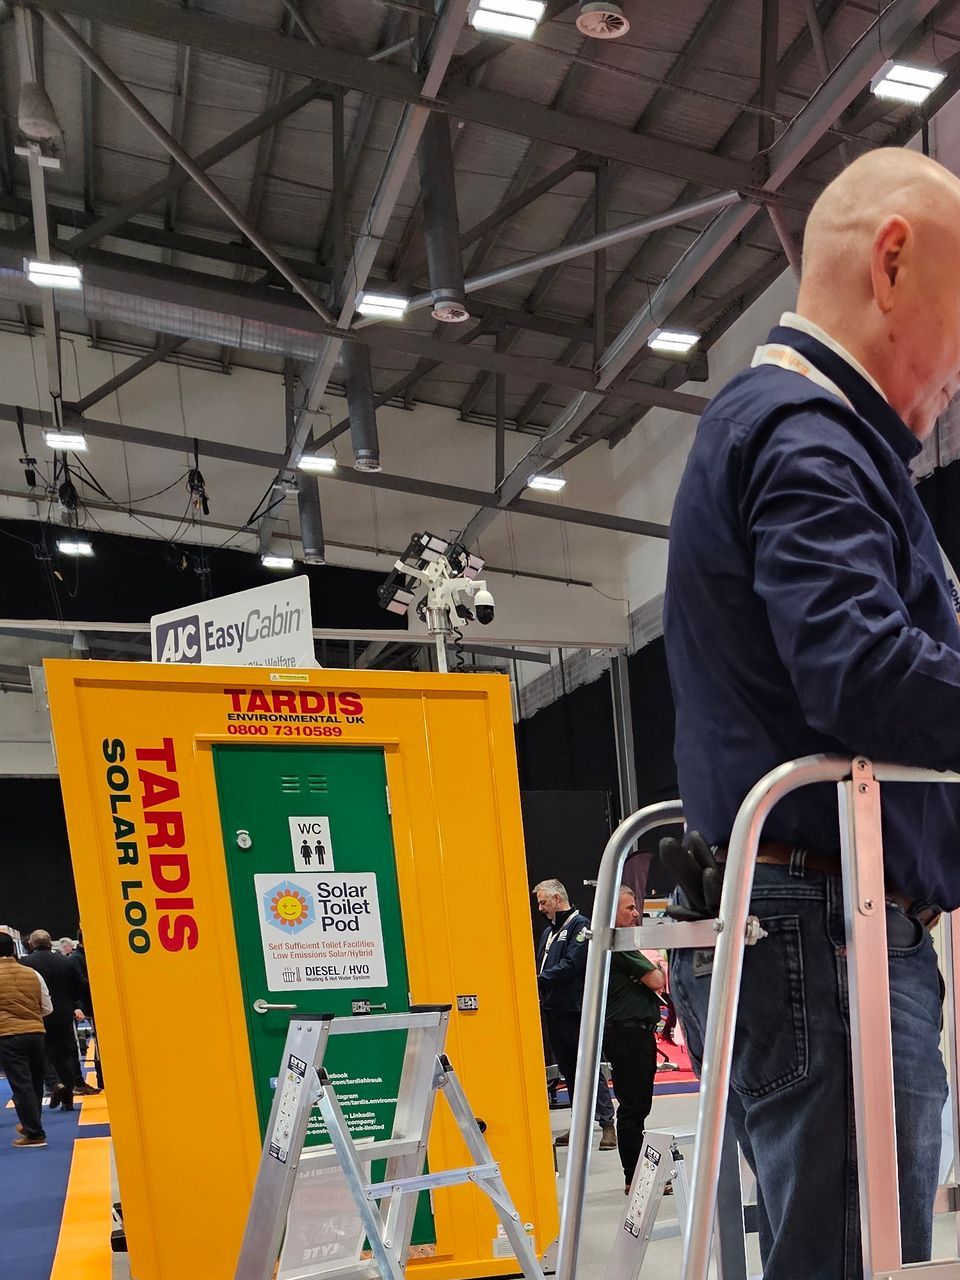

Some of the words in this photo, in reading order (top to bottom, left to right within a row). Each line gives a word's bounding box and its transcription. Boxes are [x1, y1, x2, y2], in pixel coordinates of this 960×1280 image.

[160, 625, 199, 662] AJC
[205, 601, 301, 653] EasyCabin
[224, 688, 364, 715] TARDIS
[227, 713, 342, 724] ENVIRONMENTAL
[346, 716, 365, 724] UK
[227, 724, 269, 735] 0800
[273, 725, 342, 737] 7310589
[298, 823, 321, 834] WC
[102, 737, 139, 866] SOLAR
[121, 880, 151, 954] LOO
[135, 737, 199, 953] TARDIS
[317, 882, 367, 898] Solar
[318, 900, 370, 915] Toilet
[322, 916, 360, 932] Pod
[285, 942, 320, 950] Sufficient
[343, 940, 375, 948] Facilities
[290, 951, 327, 959] Emissions
[328, 949, 373, 958] Solar/Hybrid
[305, 966, 340, 976] DIESEL
[349, 964, 370, 974] HVO
